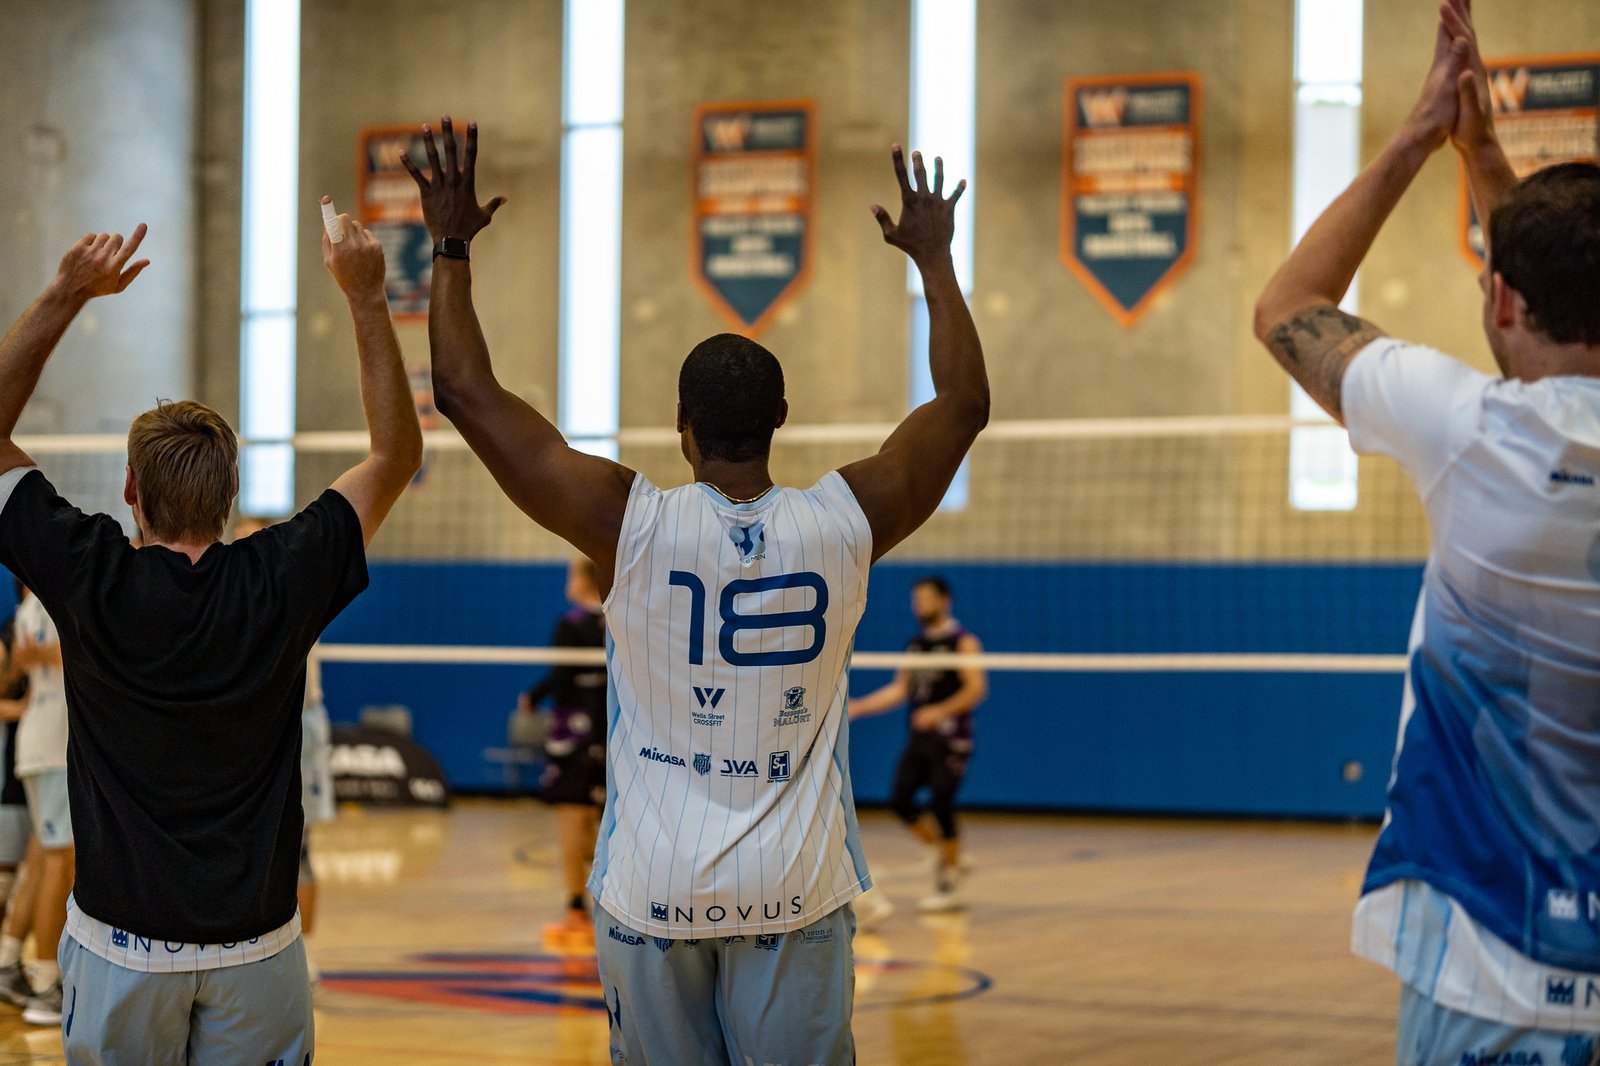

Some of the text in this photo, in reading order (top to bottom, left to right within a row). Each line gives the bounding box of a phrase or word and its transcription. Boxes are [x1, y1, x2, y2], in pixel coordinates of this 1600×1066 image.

[669, 570, 829, 666] 18
[691, 711, 707, 719] Wells
[693, 718, 723, 727] CROSSFIT
[720, 759, 759, 775] JVA
[675, 895, 802, 923] NOVUS
